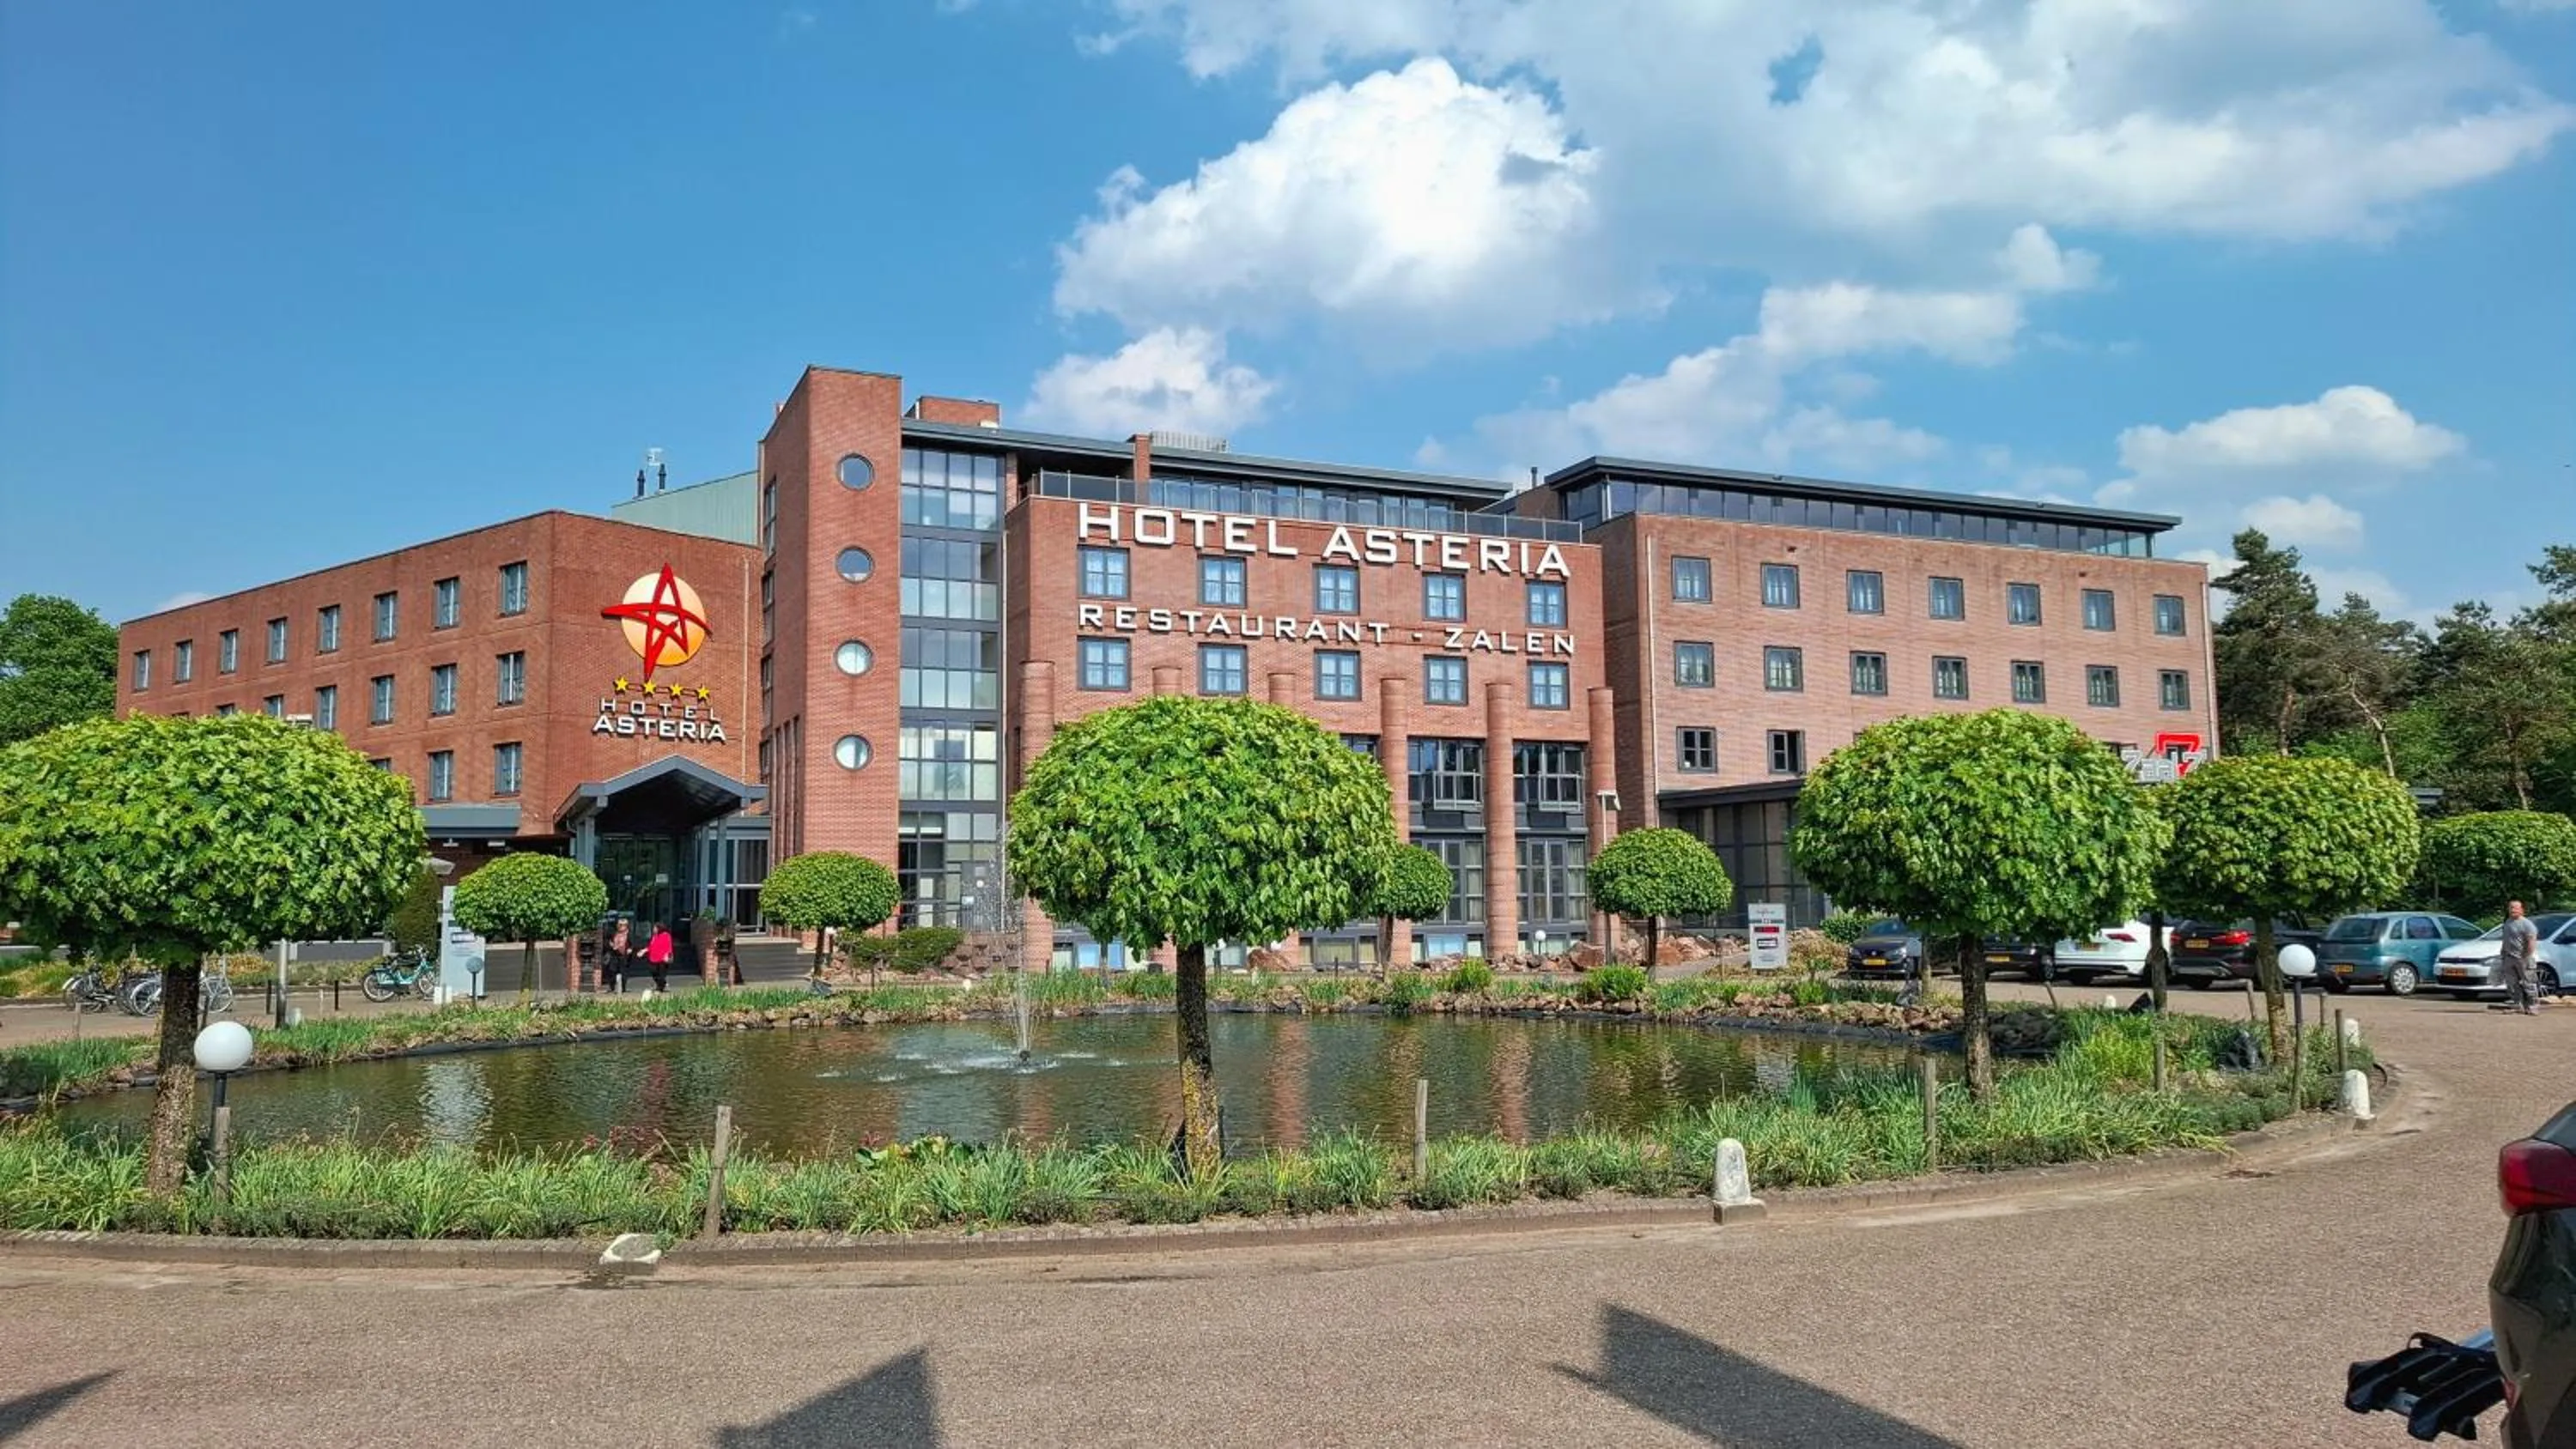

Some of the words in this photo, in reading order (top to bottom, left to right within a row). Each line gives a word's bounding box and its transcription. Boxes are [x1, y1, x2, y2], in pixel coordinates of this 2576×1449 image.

[1079, 502, 1298, 556] HOTEL
[1322, 526, 1571, 578] ASTERIA
[1079, 603, 1389, 644] RESTAURANT
[1444, 627, 1574, 654] ZALEN
[592, 715, 726, 741] ASTERIA
[600, 698, 721, 721] HOTEL
